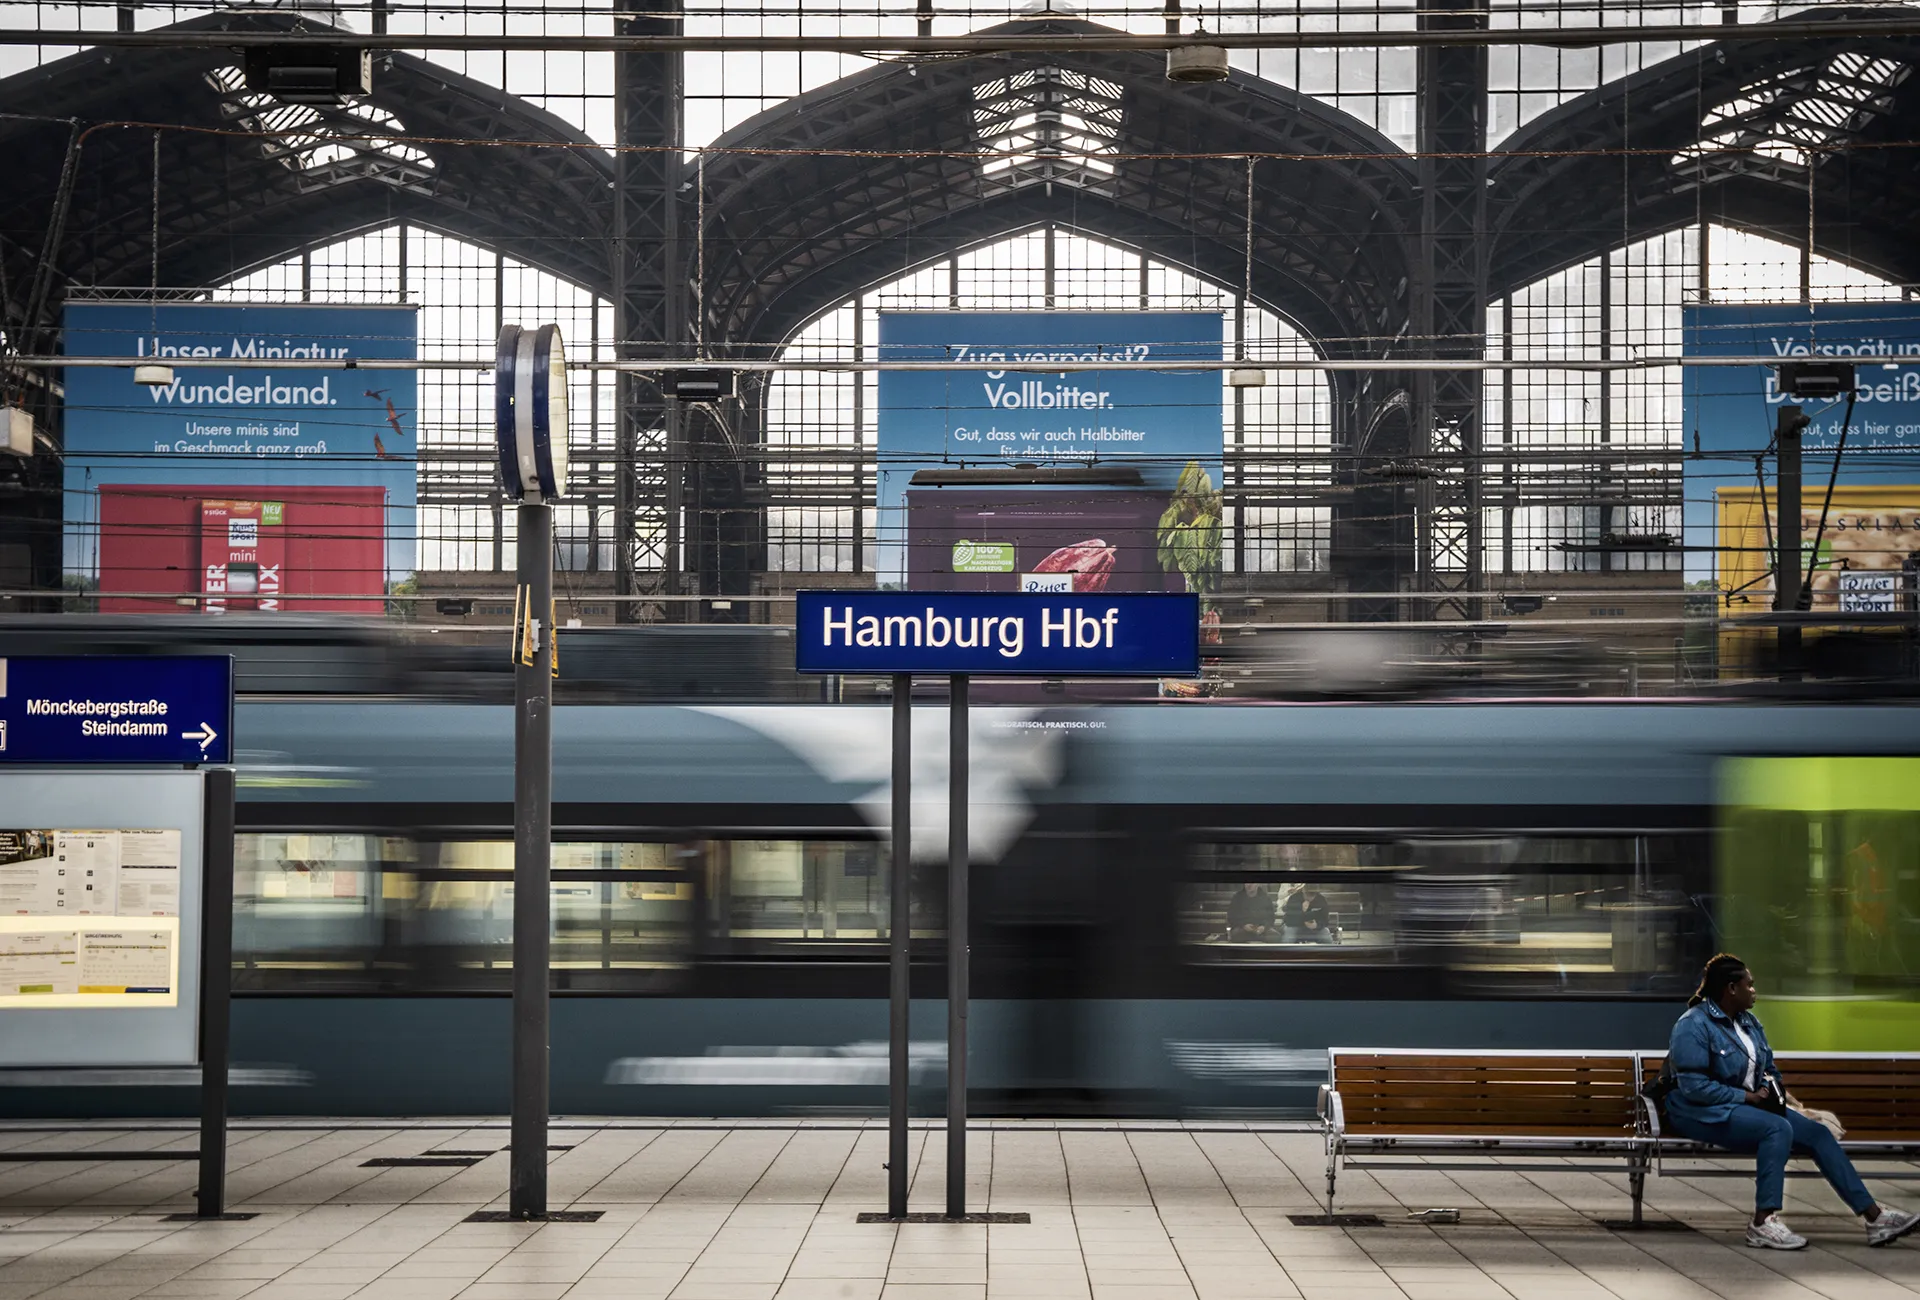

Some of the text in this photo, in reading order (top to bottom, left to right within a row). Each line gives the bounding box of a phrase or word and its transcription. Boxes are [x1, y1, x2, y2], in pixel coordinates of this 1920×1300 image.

[137, 337, 349, 358] Unser Miniatur
[149, 375, 337, 405] Wunderland.
[984, 381, 1114, 410] Vollbitter.
[185, 421, 300, 437] Unsere minis sind
[954, 426, 1146, 443] Gut, dass wir auch Halbbitter
[1864, 420, 1890, 435] hier
[154, 441, 170, 454] im
[174, 440, 252, 454] Geschmack
[256, 445, 291, 458] ganz
[1000, 445, 1018, 459] für
[1022, 445, 1049, 459] dich
[229, 549, 256, 562] mini
[976, 545, 1003, 554] 100%
[822, 606, 1120, 658] Hamburg Hbf
[26, 699, 168, 718] Mönckebergstraße
[81, 719, 168, 736] Steindamm
[1045, 721, 1089, 729] PRAKTISCH.
[1089, 721, 1107, 729] GUT.
